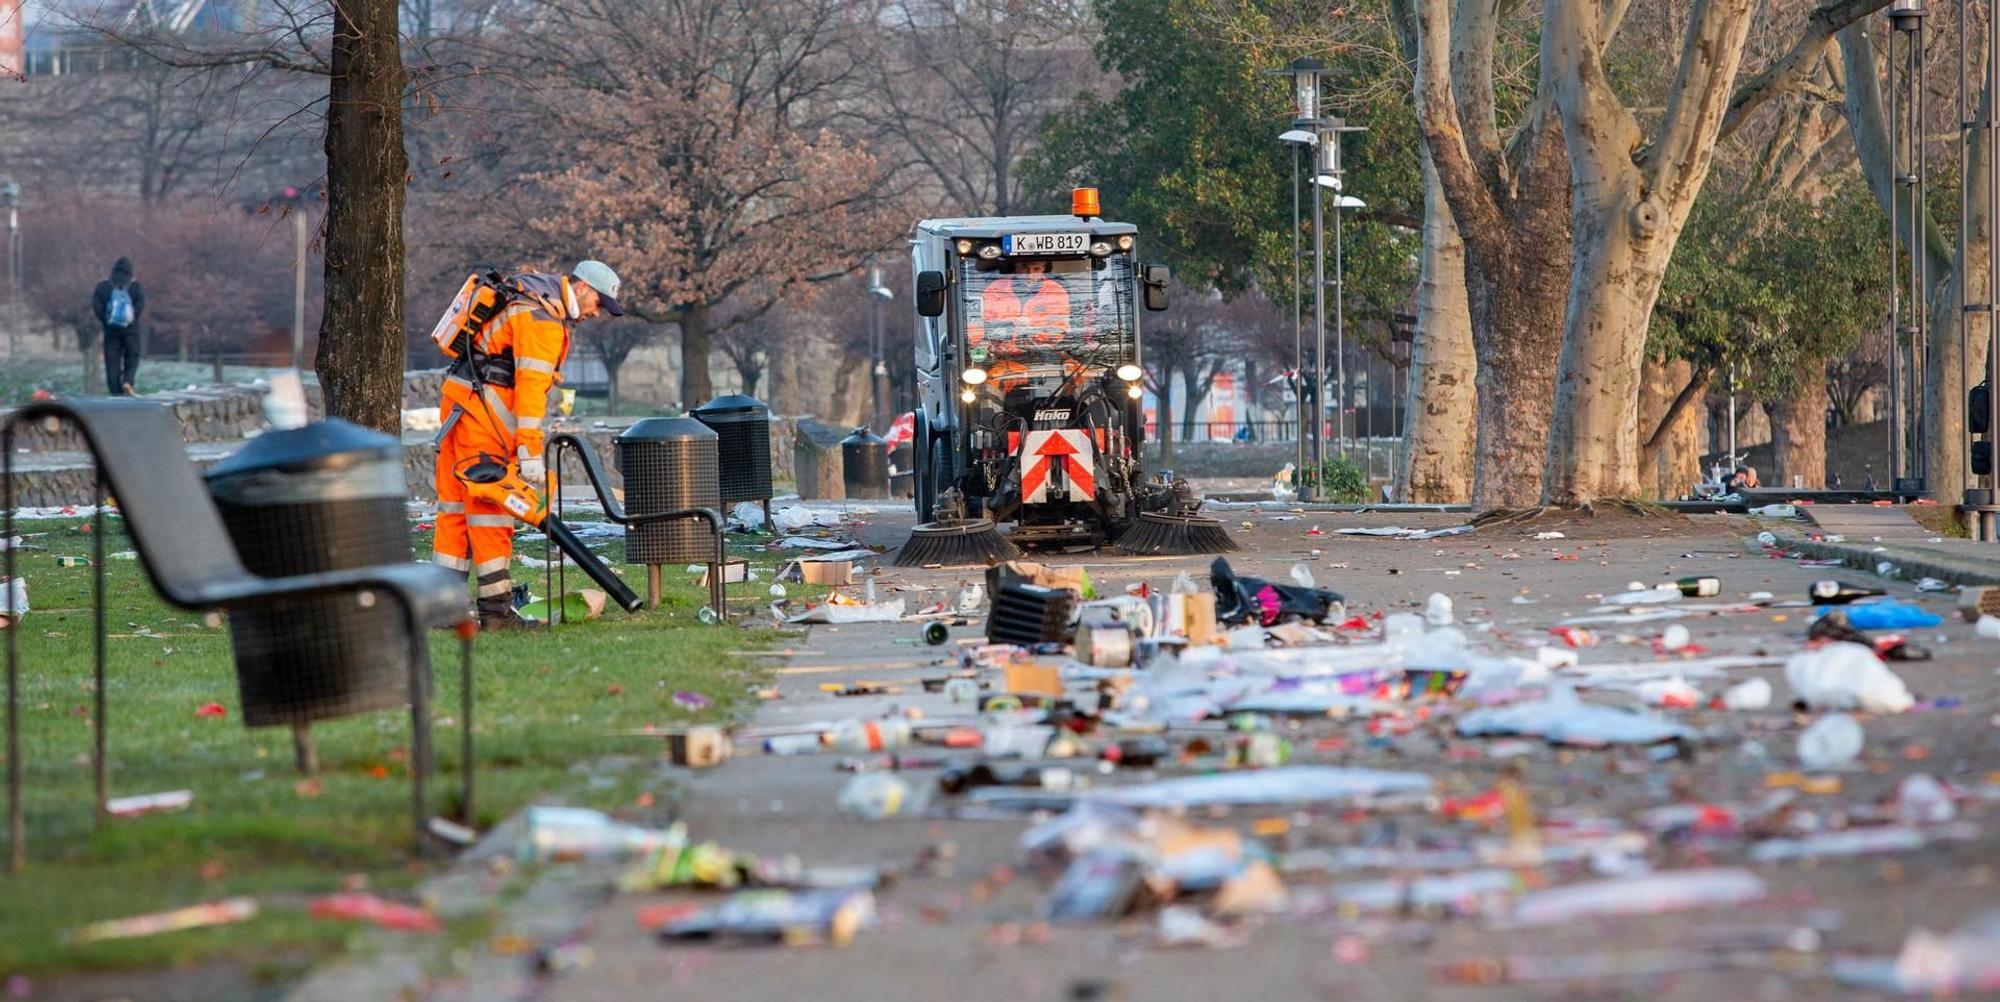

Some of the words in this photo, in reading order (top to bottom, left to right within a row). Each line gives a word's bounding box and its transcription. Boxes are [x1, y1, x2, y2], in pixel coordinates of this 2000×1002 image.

[1017, 236, 1026, 250] K
[1036, 236, 1054, 250] WB
[1058, 236, 1083, 249] 819
[1033, 409, 1071, 421] Hako
